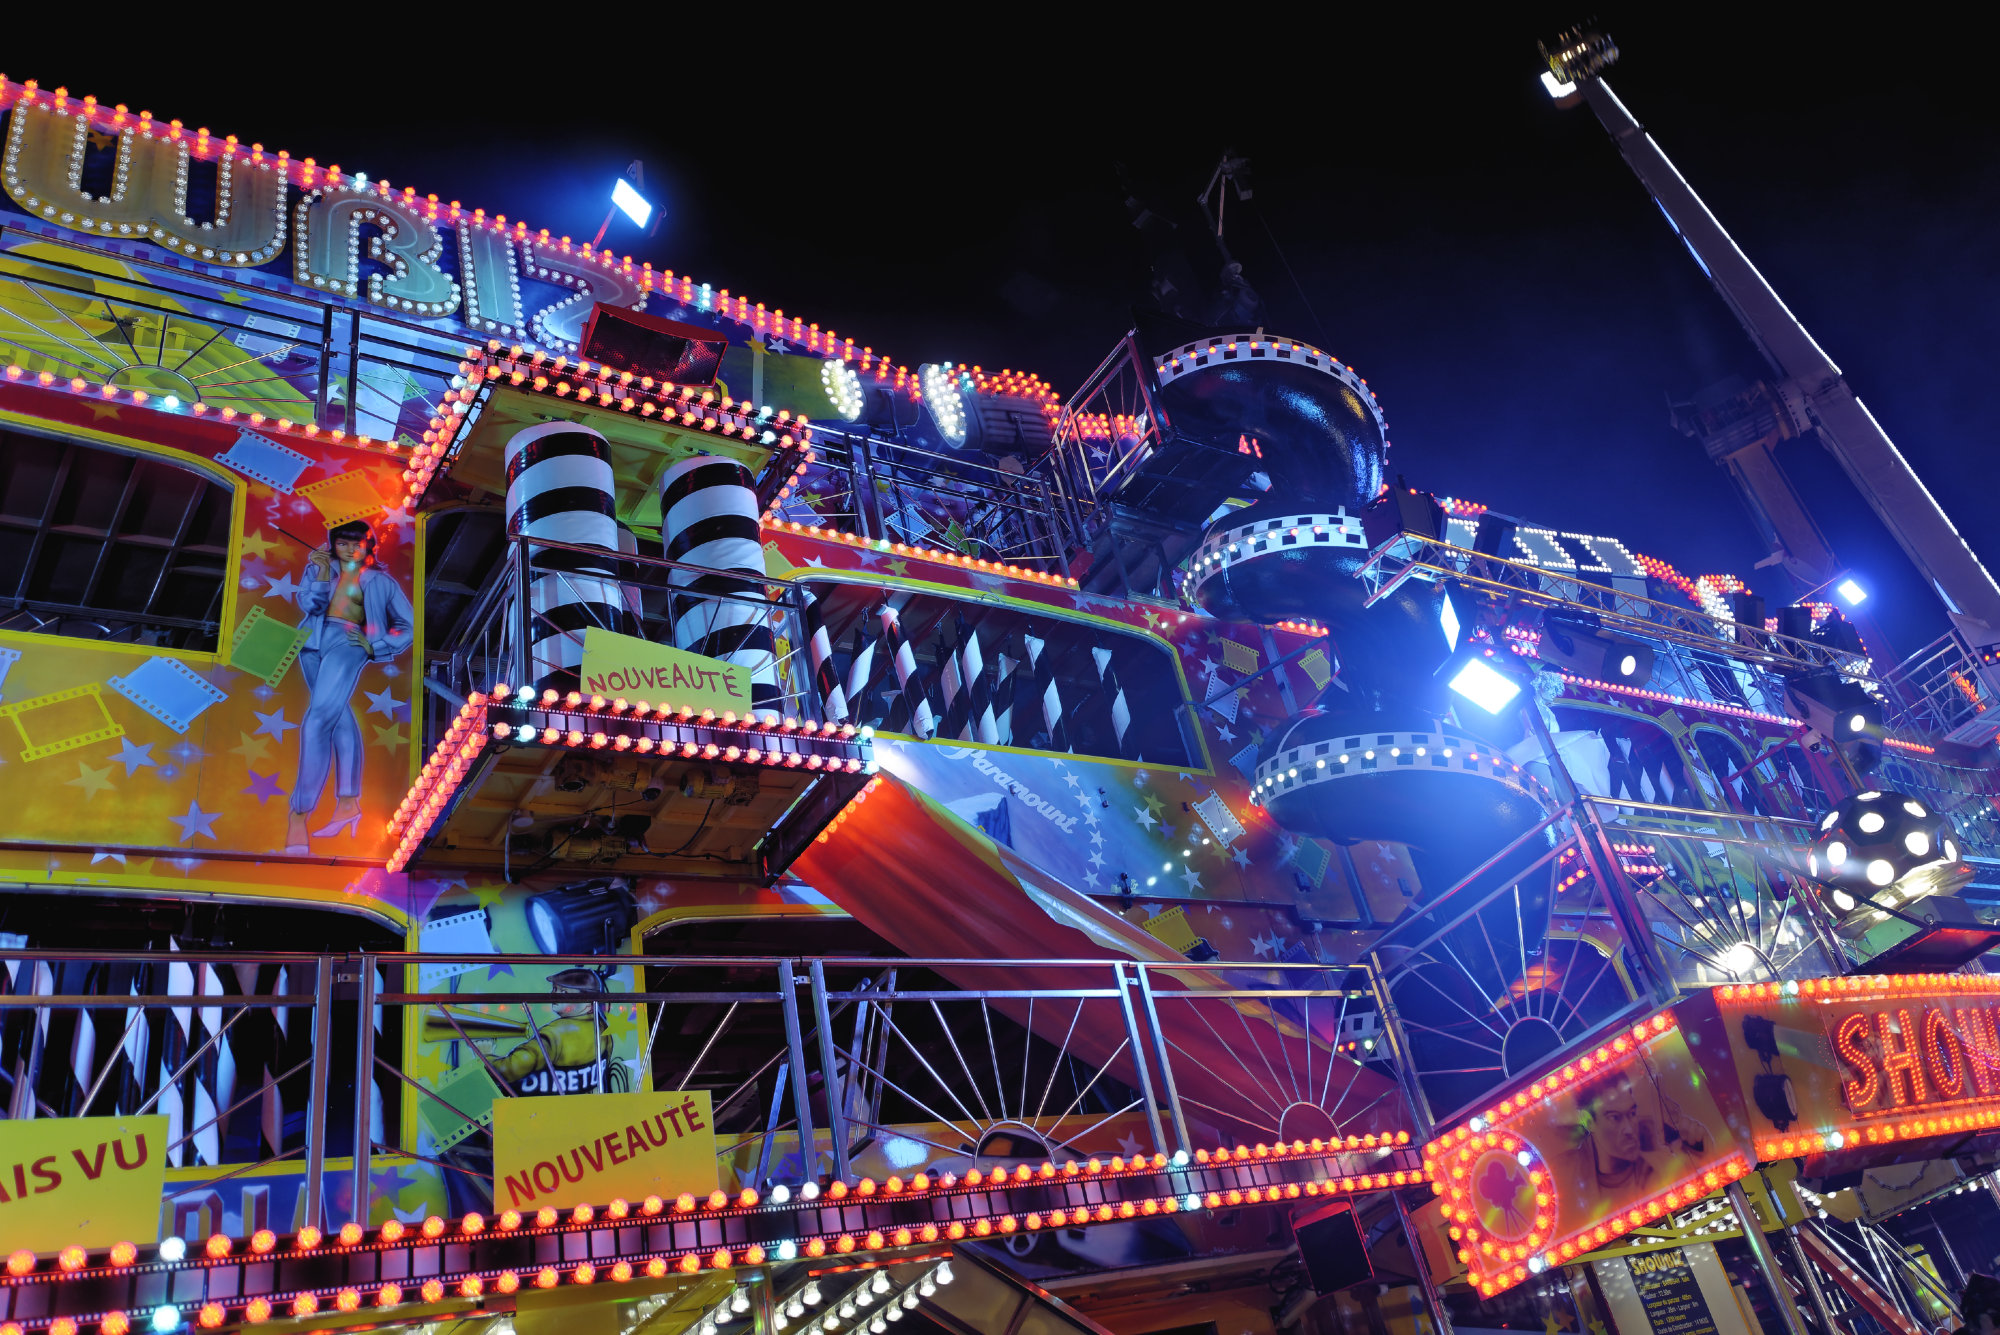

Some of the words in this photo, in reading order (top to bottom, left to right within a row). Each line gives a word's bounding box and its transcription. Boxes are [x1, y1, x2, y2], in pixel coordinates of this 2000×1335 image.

[587, 662, 743, 698] NOUVEAUTÉ
[71, 1133, 148, 1181] VU
[504, 1095, 706, 1207] NOUVEAUTÉ
[1631, 1251, 1684, 1276] SHOWBIZ
